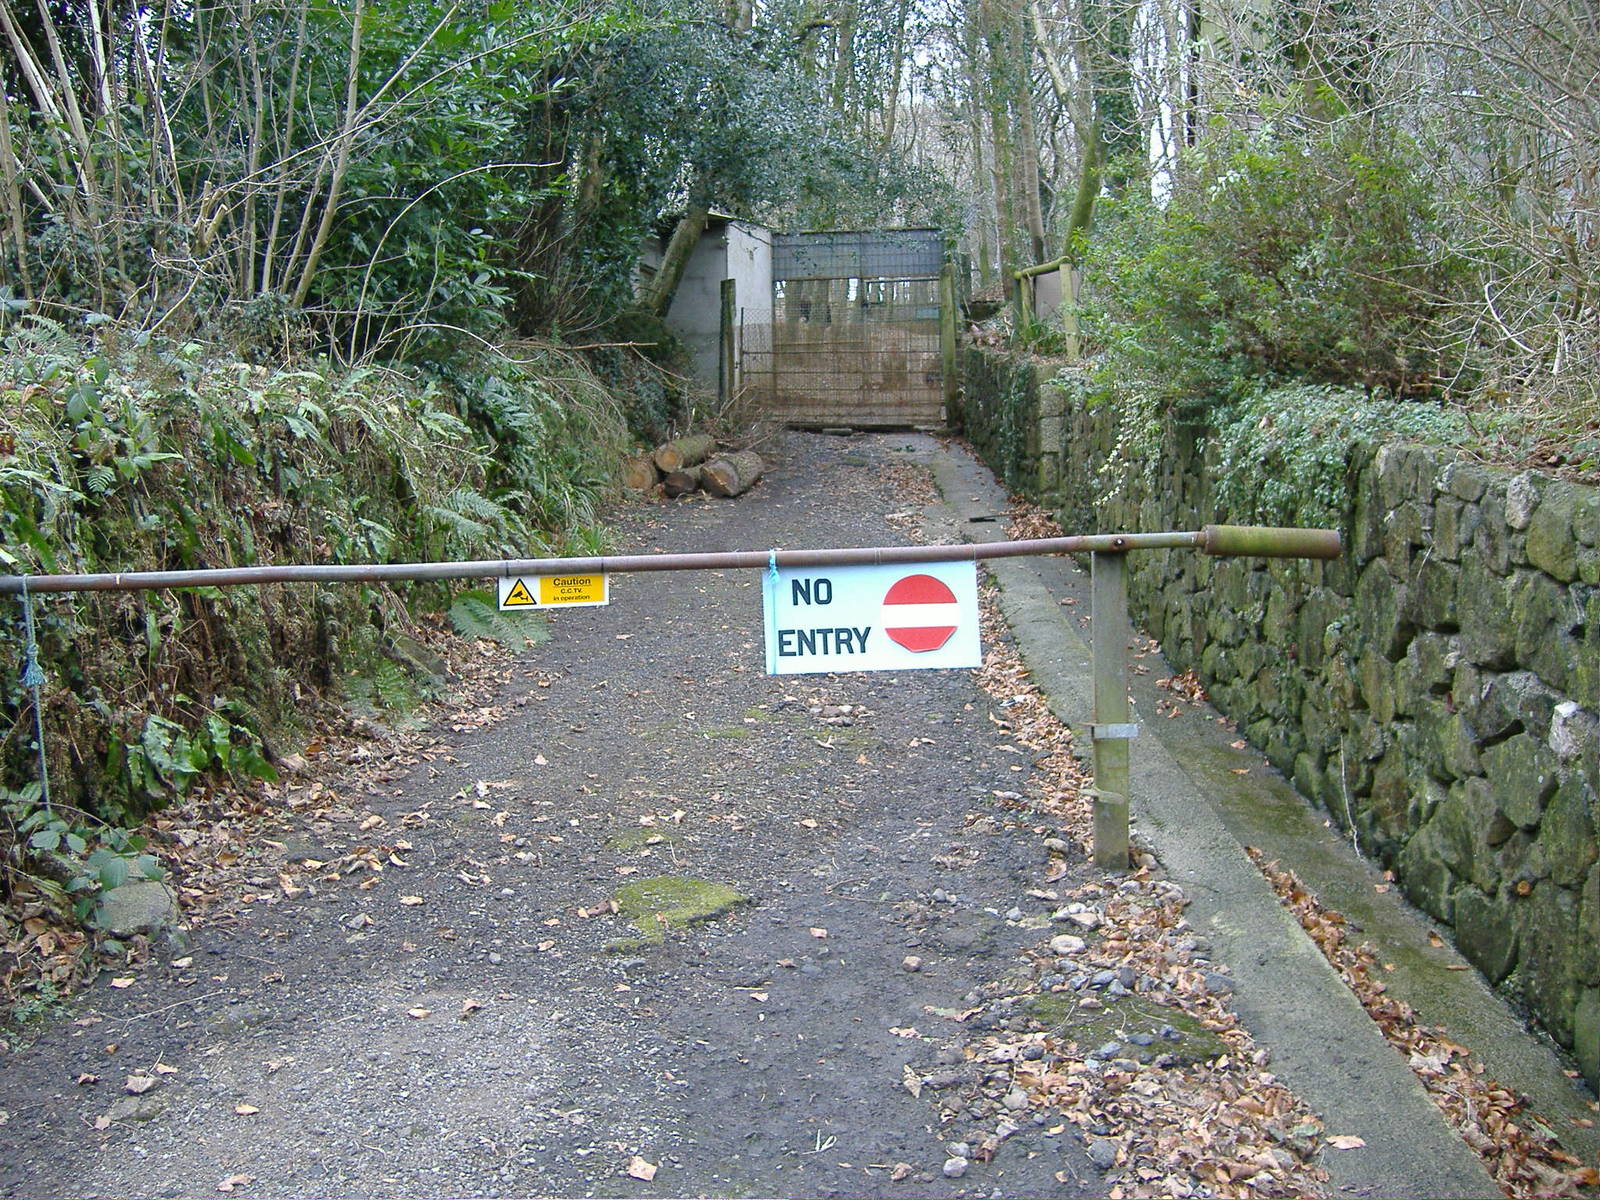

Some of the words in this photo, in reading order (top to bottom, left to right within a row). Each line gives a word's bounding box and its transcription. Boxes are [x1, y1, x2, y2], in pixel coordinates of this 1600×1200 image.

[553, 577, 591, 586] Caution
[791, 578, 833, 606] NO
[778, 626, 872, 657] ENTRY
